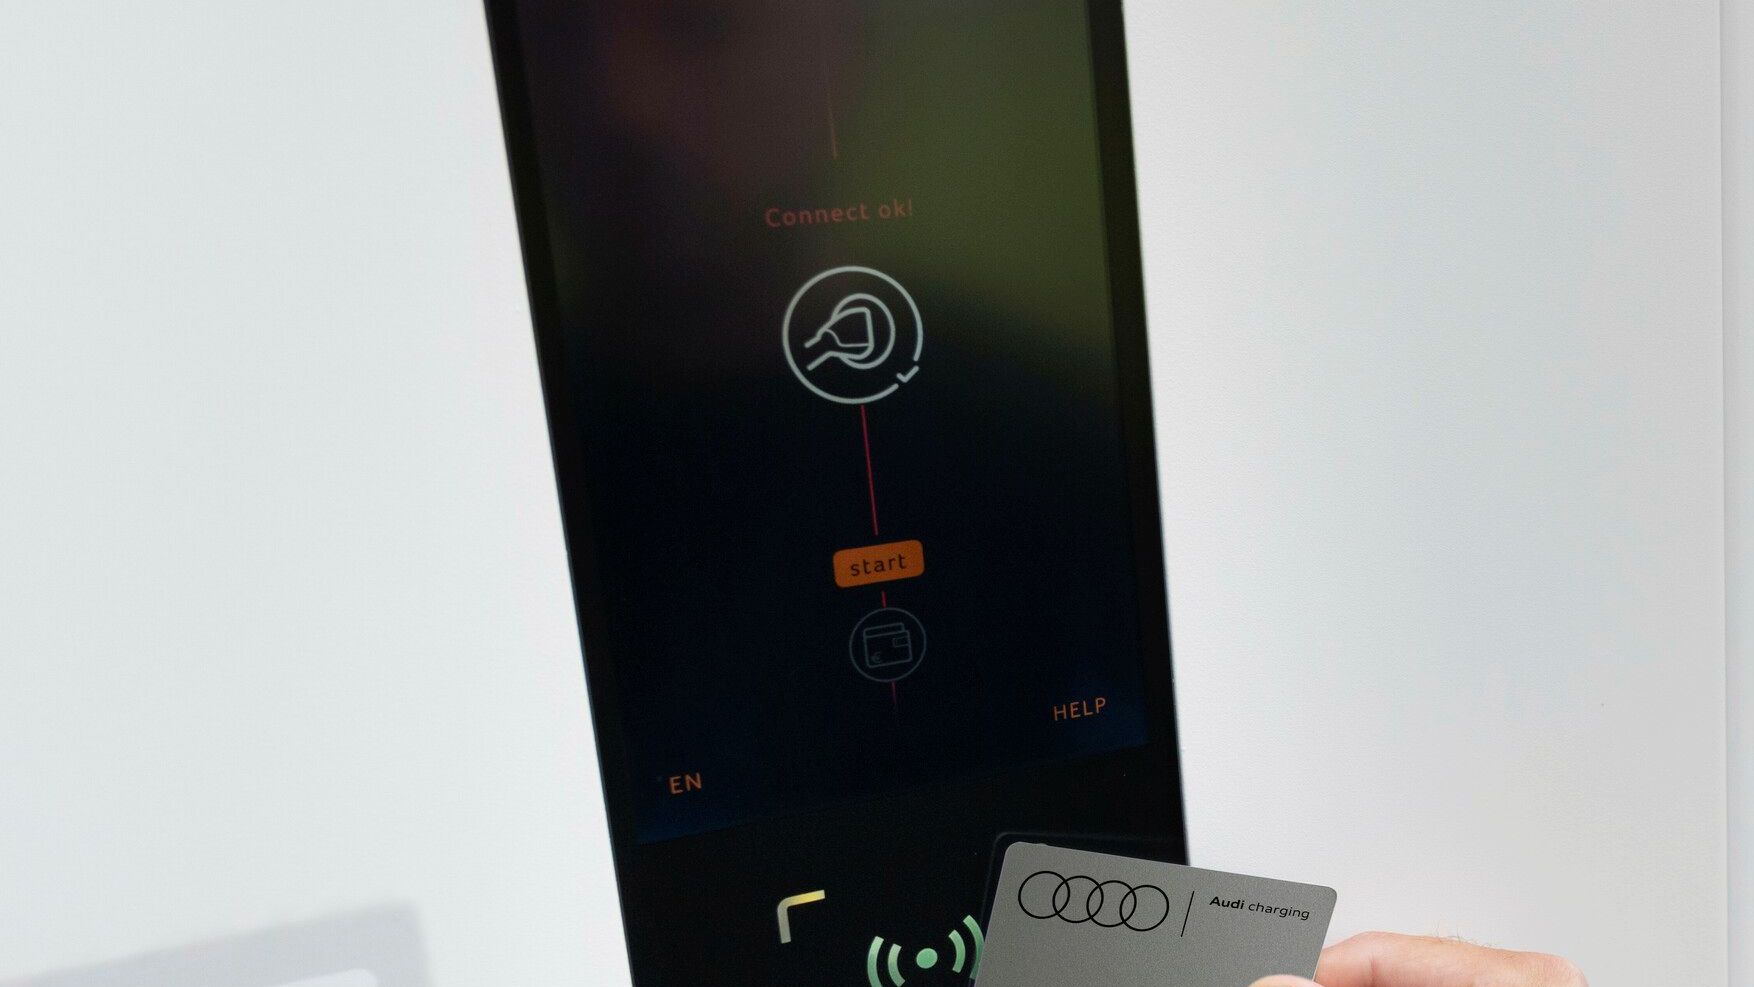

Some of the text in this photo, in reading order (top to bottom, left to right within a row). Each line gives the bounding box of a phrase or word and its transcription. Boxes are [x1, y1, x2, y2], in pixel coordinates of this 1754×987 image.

[764, 198, 913, 229] Connect ok!
[849, 553, 907, 578] start
[1053, 697, 1106, 722] HELP
[669, 772, 702, 795] EN
[1209, 896, 1310, 921] Audi charging
